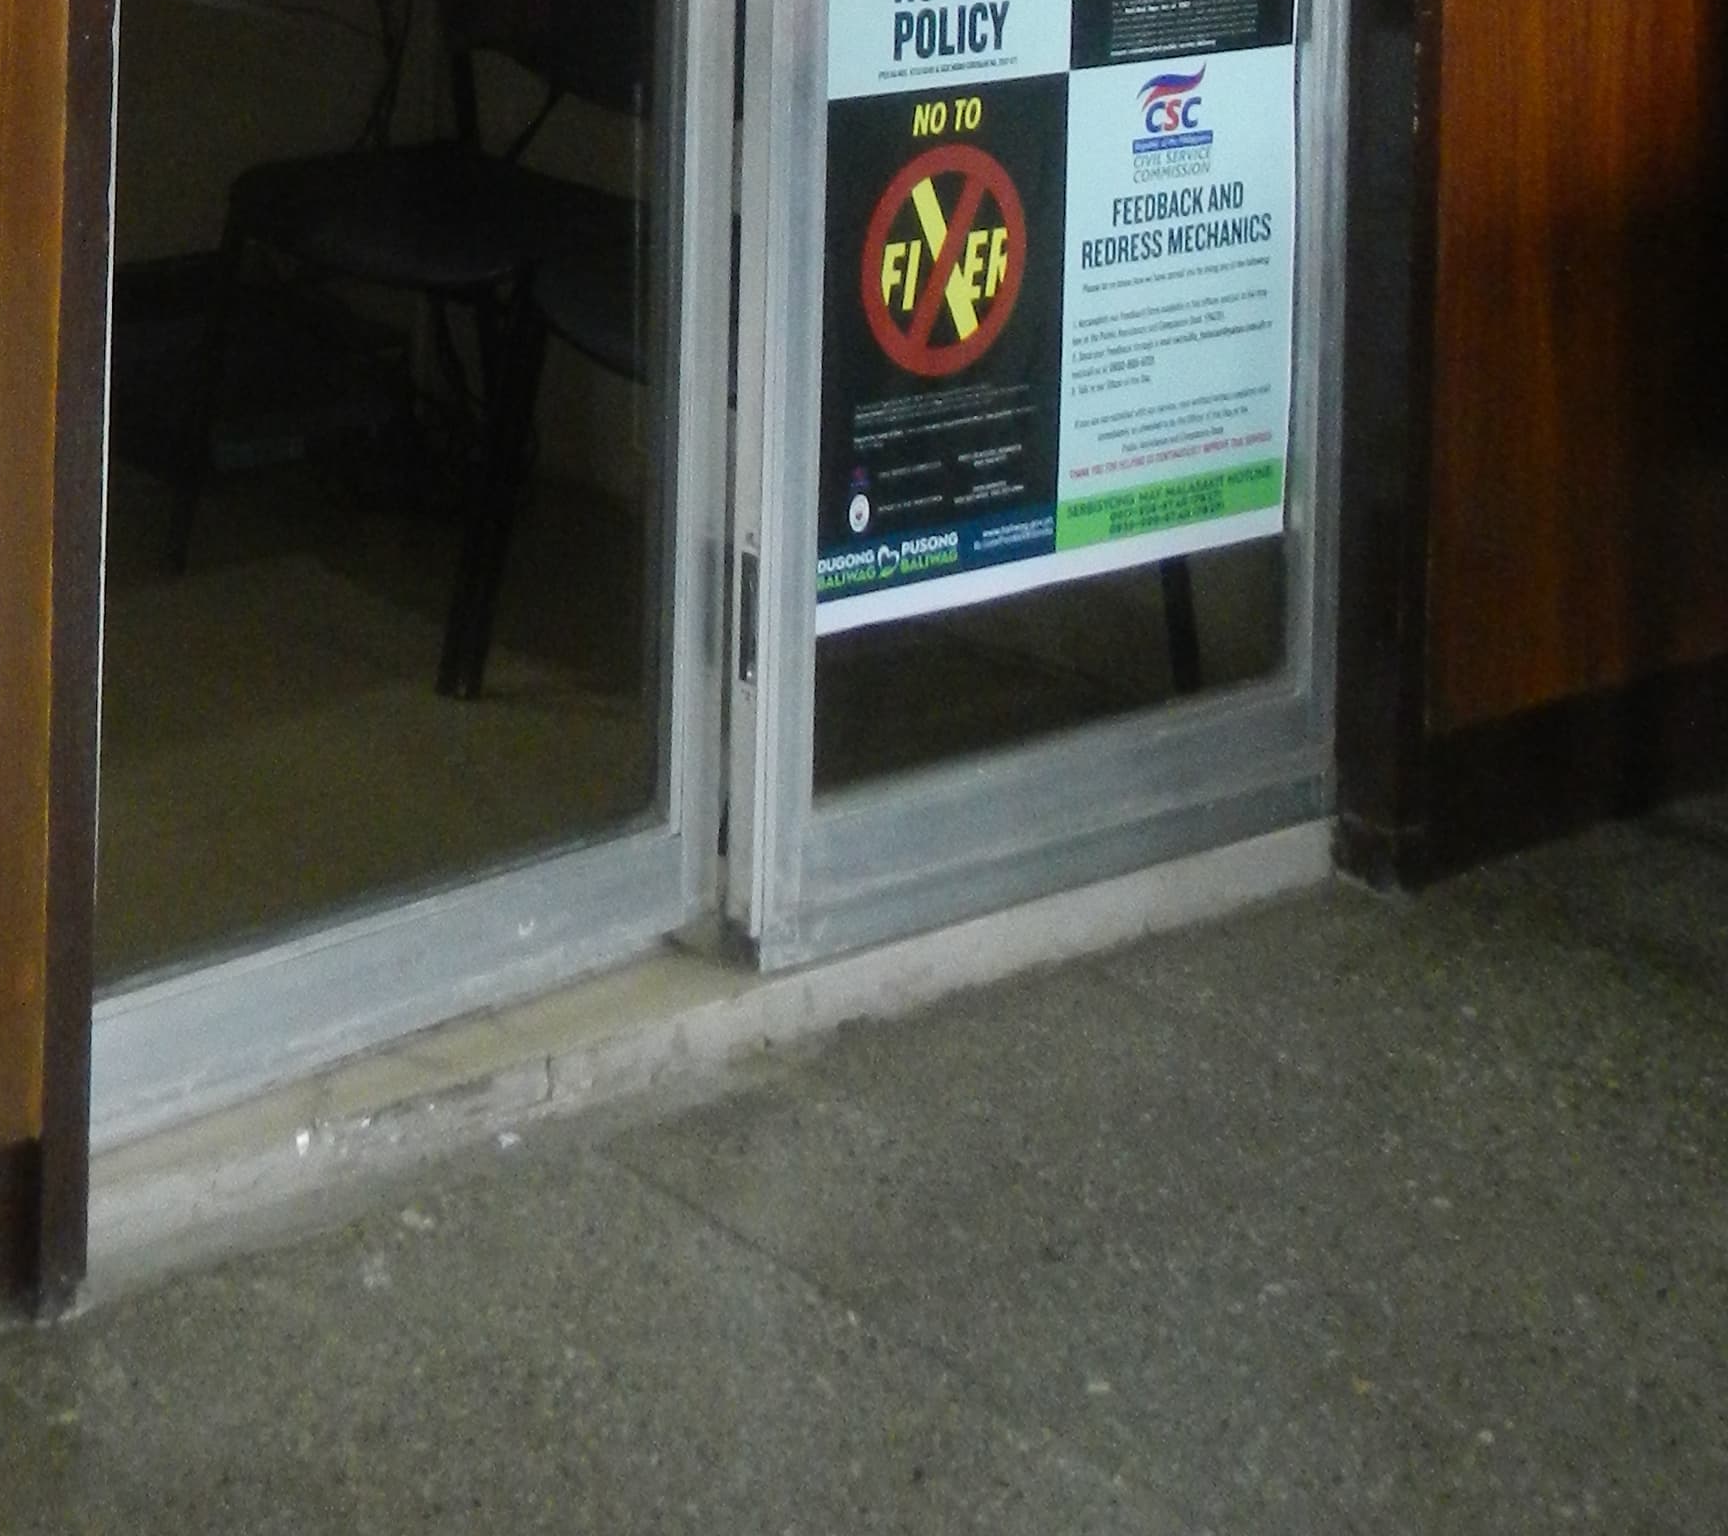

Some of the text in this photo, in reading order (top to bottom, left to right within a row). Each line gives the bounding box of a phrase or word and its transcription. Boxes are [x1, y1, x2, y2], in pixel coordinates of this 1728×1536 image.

[893, 0, 1011, 62] POLICY
[912, 96, 983, 137] NO TO
[1145, 96, 1203, 134] CSC
[1133, 147, 1212, 170] CIVIL SERVICE
[1133, 162, 1212, 184] COMMISSION
[1112, 180, 1245, 228] FEEDBACK AND
[1081, 212, 1273, 271] REDRESS MECHANICS
[901, 531, 959, 556] PUSONG
[817, 549, 876, 574] DUGONG
[900, 549, 959, 574] BALIWAG
